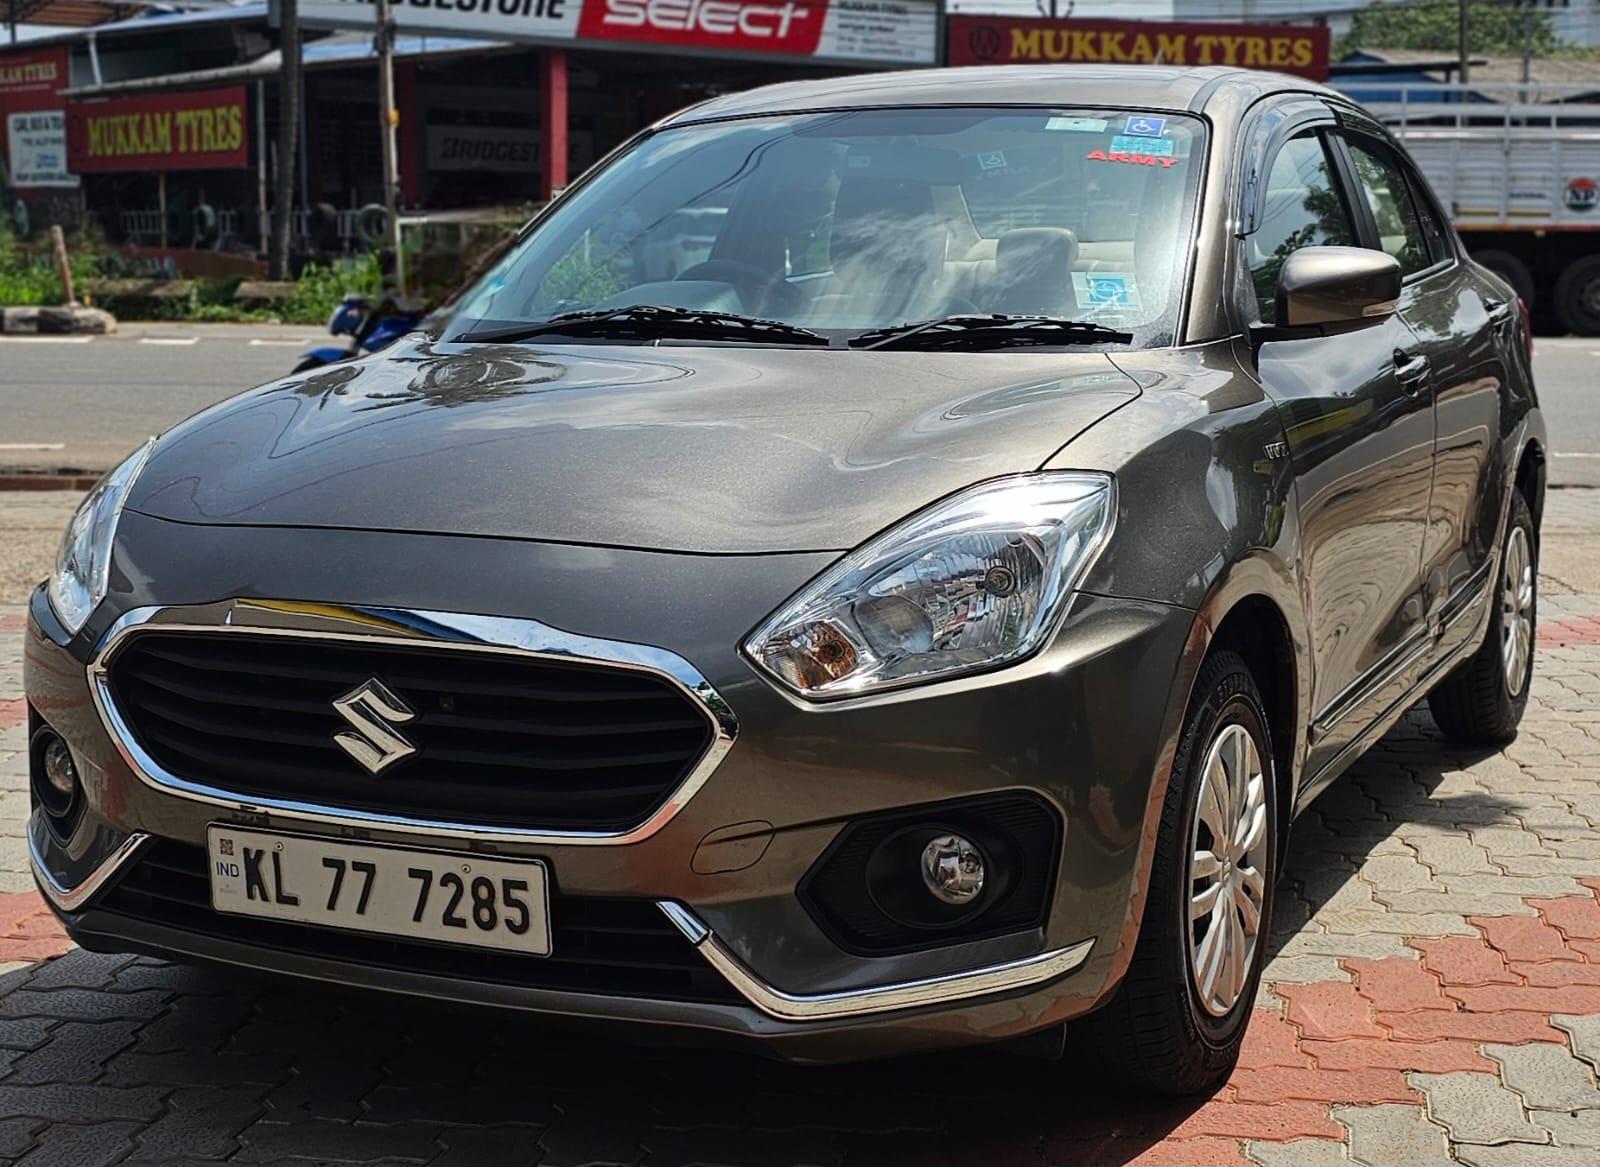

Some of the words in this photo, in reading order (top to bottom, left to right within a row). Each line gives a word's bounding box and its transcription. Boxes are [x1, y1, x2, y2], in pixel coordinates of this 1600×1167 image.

[1010, 28, 1186, 64] MUKKAM
[1194, 35, 1313, 66] TYRES
[87, 112, 171, 156] MUKKAM
[176, 105, 242, 152] TYRES
[1086, 150, 1179, 168] ARMY
[216, 861, 240, 878] IND
[243, 847, 300, 906] KL
[322, 857, 377, 915] 77
[408, 867, 531, 936] 7285
